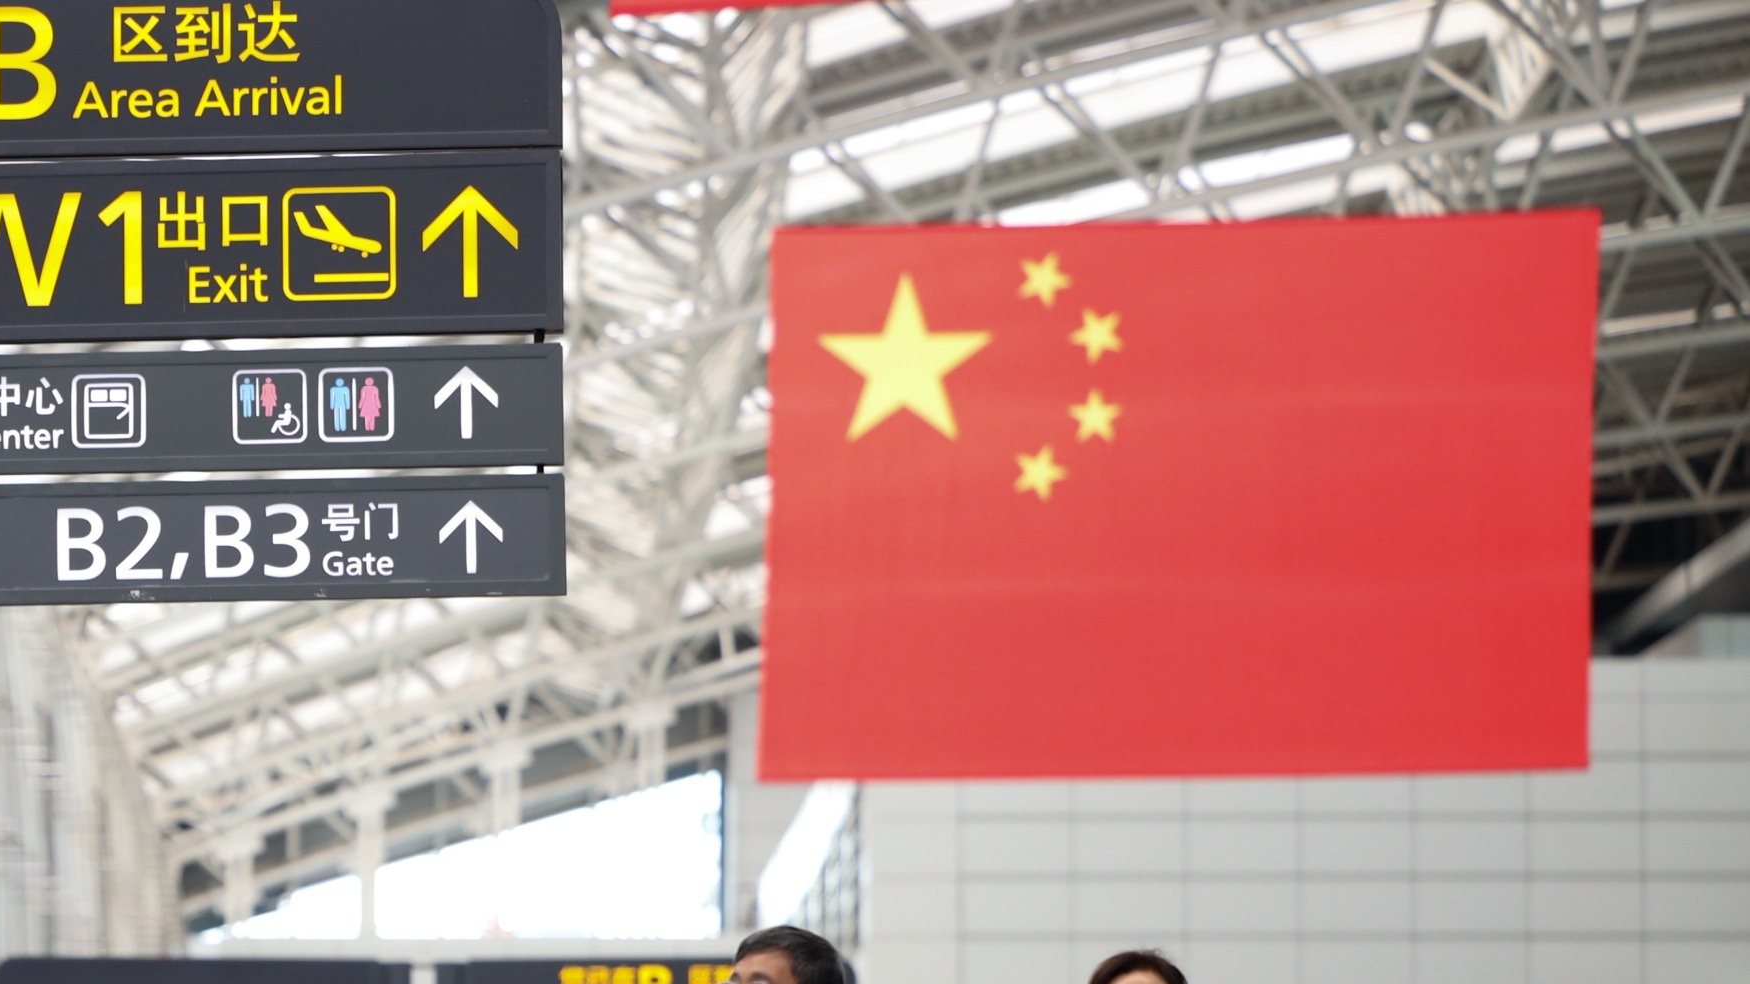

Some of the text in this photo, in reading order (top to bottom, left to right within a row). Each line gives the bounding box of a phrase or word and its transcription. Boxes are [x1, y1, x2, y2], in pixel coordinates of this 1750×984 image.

[113, 1, 301, 64] 区到达
[73, 81, 180, 119] Area
[194, 75, 342, 117] Arrival
[157, 191, 269, 251] 出口
[188, 264, 269, 304] Exit
[321, 502, 399, 542] 号门
[322, 550, 395, 577] Gate
